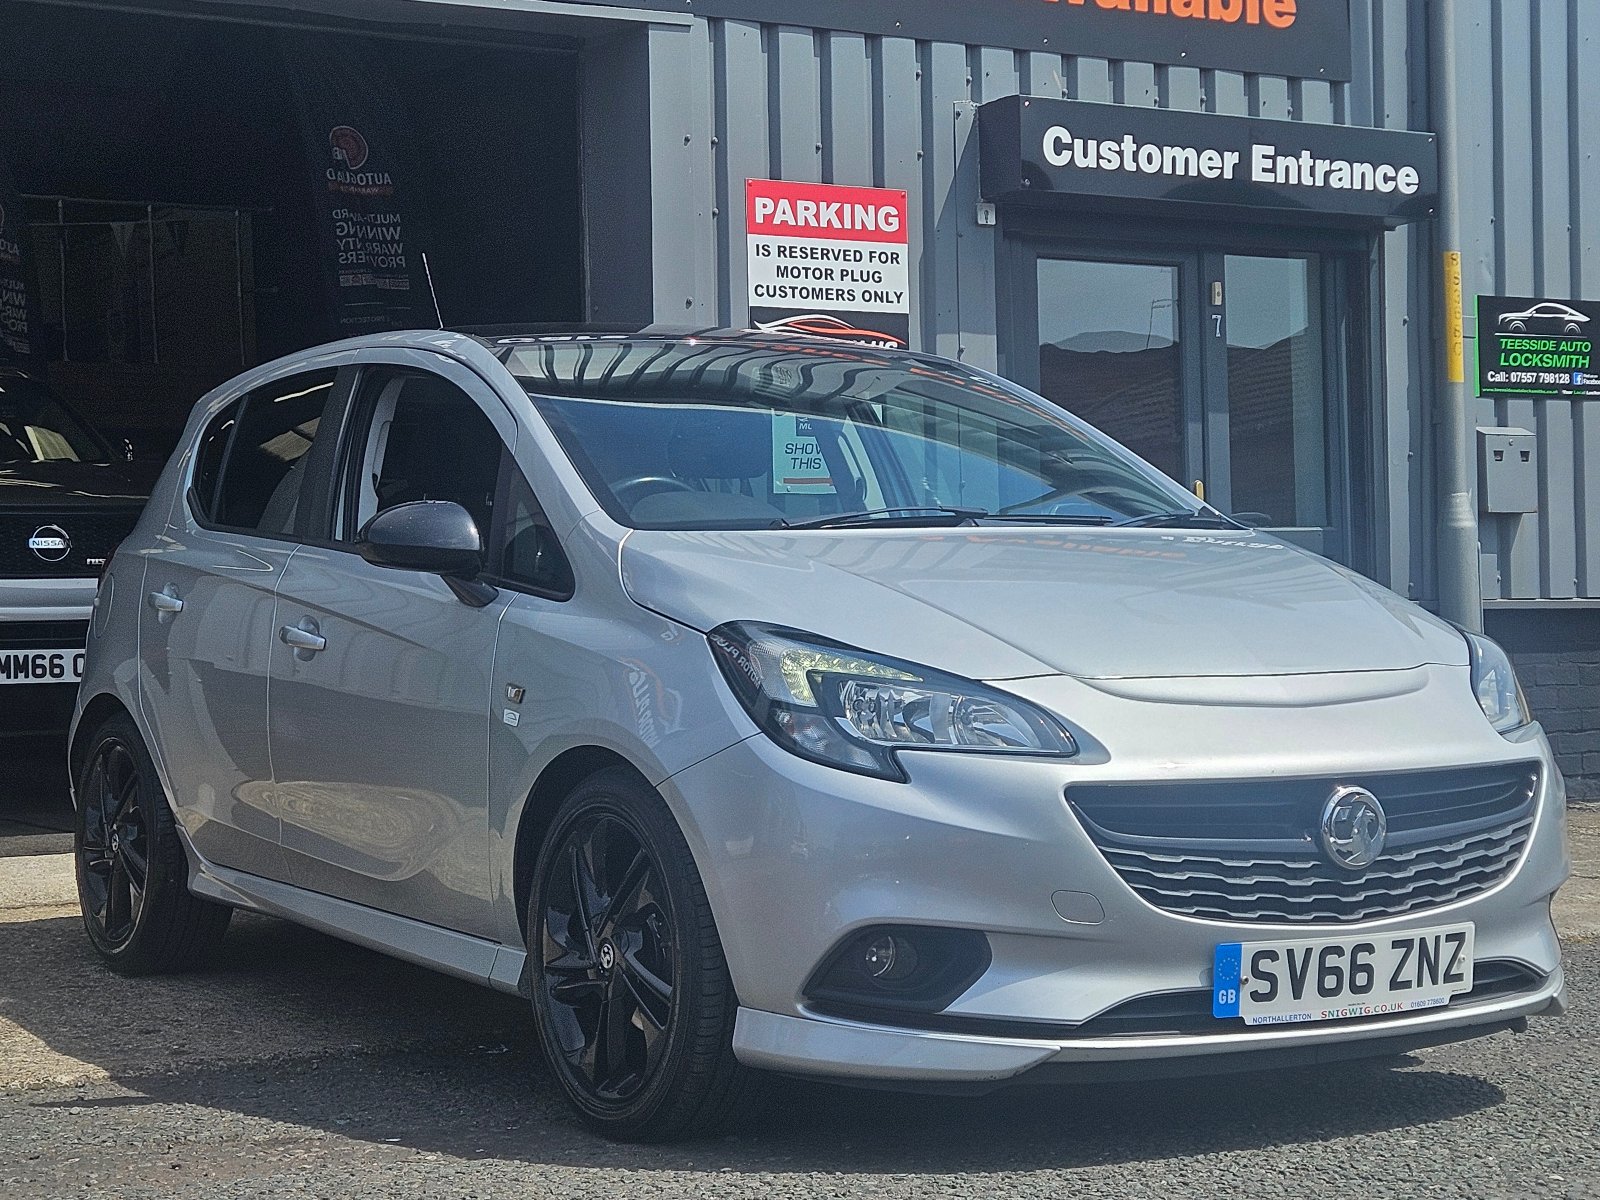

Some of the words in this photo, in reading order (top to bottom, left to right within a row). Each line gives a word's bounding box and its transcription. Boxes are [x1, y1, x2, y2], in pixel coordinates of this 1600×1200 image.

[1042, 125, 1239, 180] Customer
[1251, 143, 1420, 195] Entrance
[755, 197, 900, 232] PARKING
[755, 243, 771, 257] IS
[777, 245, 863, 263] RESERVED
[869, 251, 901, 265] FOR
[776, 265, 835, 281] MOTOR
[840, 269, 883, 284] PLUG
[754, 284, 856, 302] CUSTOMERS
[861, 290, 904, 304] ONLY
[1212, 314, 1222, 338] 7
[1500, 339, 1557, 351] TEESSIDE
[1559, 340, 1591, 352] AUTO
[1500, 353, 1590, 368] LOCKSMITH
[1488, 371, 1509, 382] Call:
[1510, 371, 1537, 383] 07557
[1538, 372, 1570, 384] 798128
[791, 457, 821, 469] THIS
[0, 653, 65, 679] MM66
[1250, 943, 1376, 1003] SV66
[1389, 932, 1466, 991] ZNZ
[1218, 989, 1236, 1004] GB
[1252, 1013, 1312, 1023] NORTHALLERTON
[1321, 1003, 1403, 1019] SNIGWIG.CO.UK
